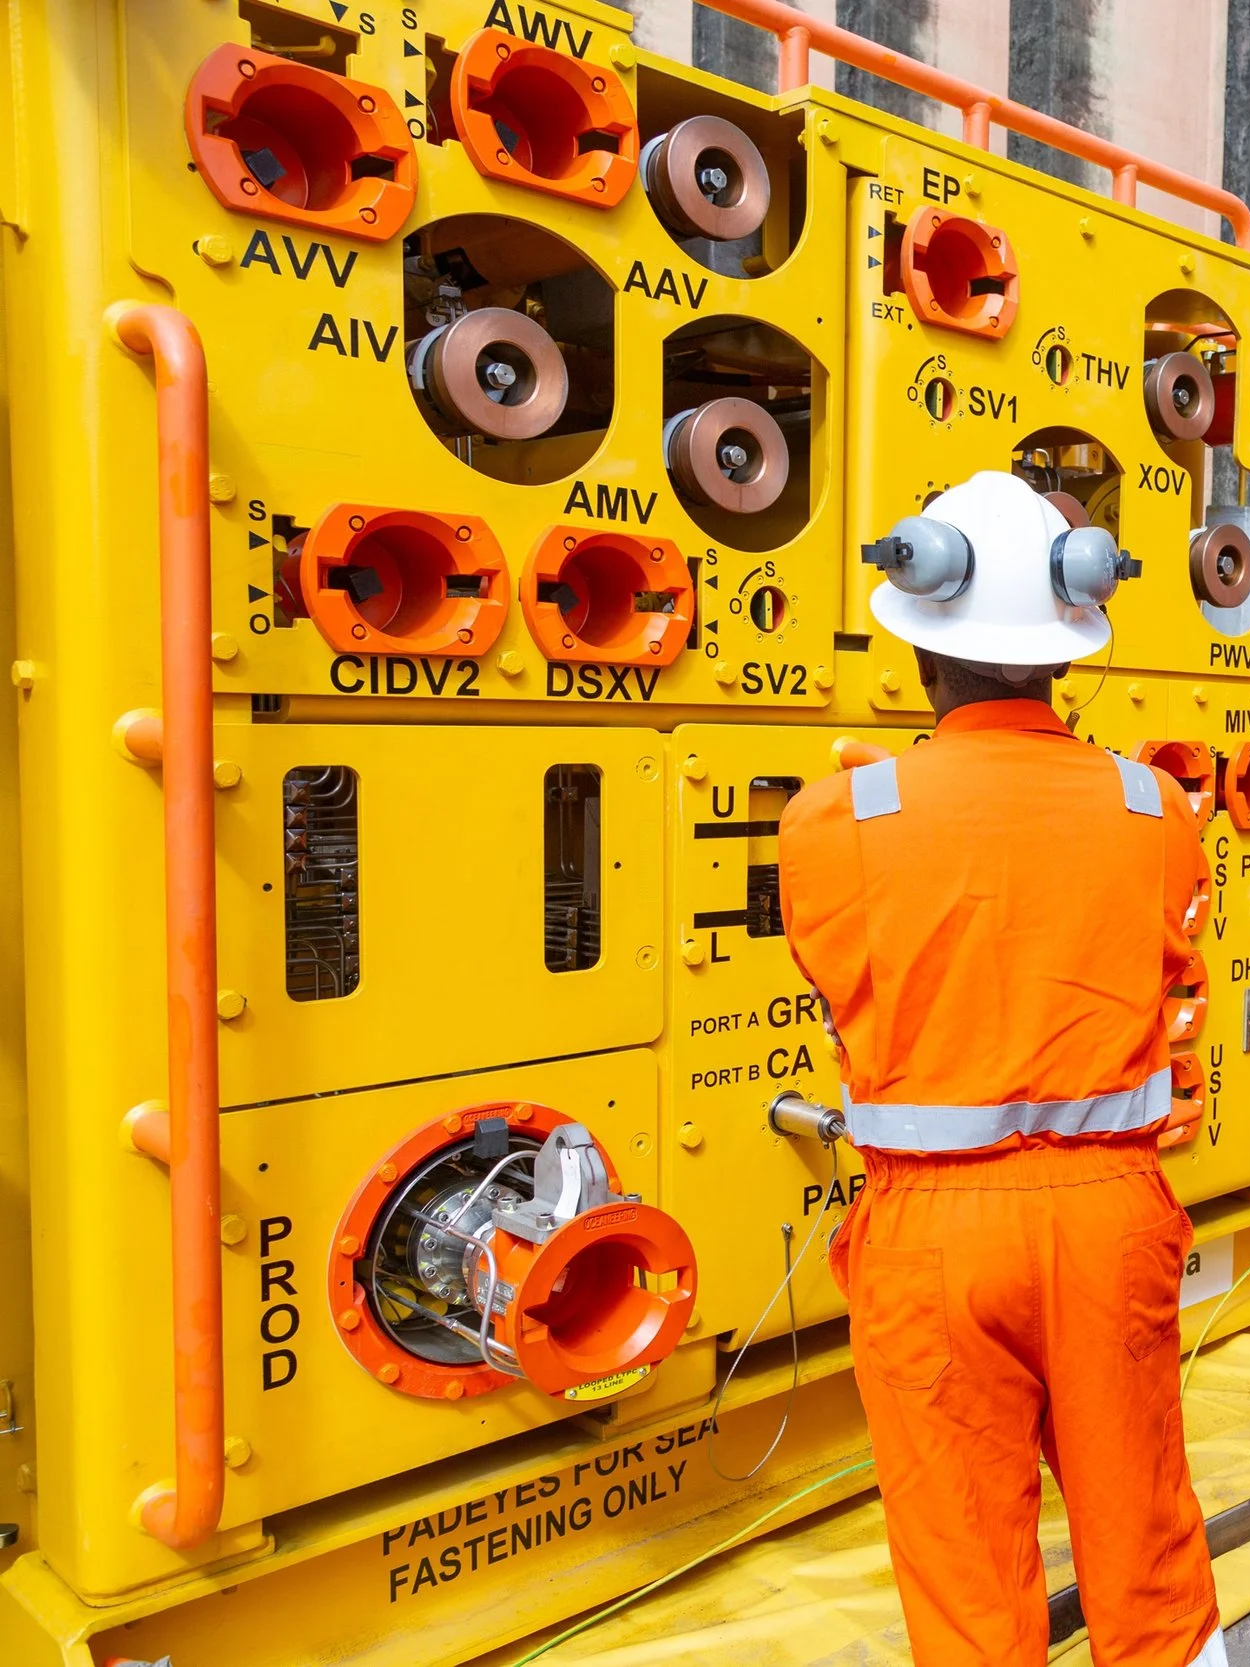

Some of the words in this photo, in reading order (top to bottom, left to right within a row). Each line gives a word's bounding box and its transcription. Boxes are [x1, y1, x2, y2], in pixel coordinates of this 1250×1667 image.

[359, 13, 375, 35] S
[402, 8, 417, 30] S
[483, 0, 593, 60] AWV
[407, 118, 425, 139] O
[870, 183, 904, 205] RET
[923, 167, 960, 204] EP
[239, 229, 359, 288] AVV
[622, 260, 708, 310] AAV
[873, 303, 904, 323] EXT
[308, 313, 398, 362] AIV
[1058, 326, 1065, 340] S
[938, 355, 946, 370] S
[1032, 351, 1041, 365] O
[1082, 353, 1130, 389] THV
[907, 386, 918, 401] O
[969, 387, 1016, 423] SV1
[1139, 463, 1186, 495] XOV
[249, 500, 266, 521] S
[564, 481, 657, 524] AMV
[706, 549, 717, 565] S
[765, 561, 775, 577] S
[729, 593, 743, 615] O
[250, 614, 270, 634] O
[706, 642, 718, 658] O
[329, 655, 480, 697] CIDV2
[546, 662, 661, 701] DSXV
[742, 662, 806, 695] SV2
[1209, 746, 1215, 758] S
[713, 786, 734, 818] U
[1214, 837, 1228, 940] CSIV
[711, 932, 730, 963] L
[692, 1014, 742, 1036] PORT
[748, 1012, 759, 1027] A
[692, 1067, 742, 1089] PORT
[749, 1065, 759, 1080] B
[767, 1045, 814, 1078] CA
[1209, 1045, 1223, 1146] USIV
[260, 1216, 299, 1391] PROD
[578, 1375, 613, 1390] LOOPED
[604, 1378, 623, 1388] LINE
[383, 1476, 560, 1556] PADEYES
[574, 1442, 644, 1486] FOR
[655, 1417, 719, 1454] SEA
[390, 1497, 592, 1603] FASTENING
[603, 1460, 687, 1517] ONLY
